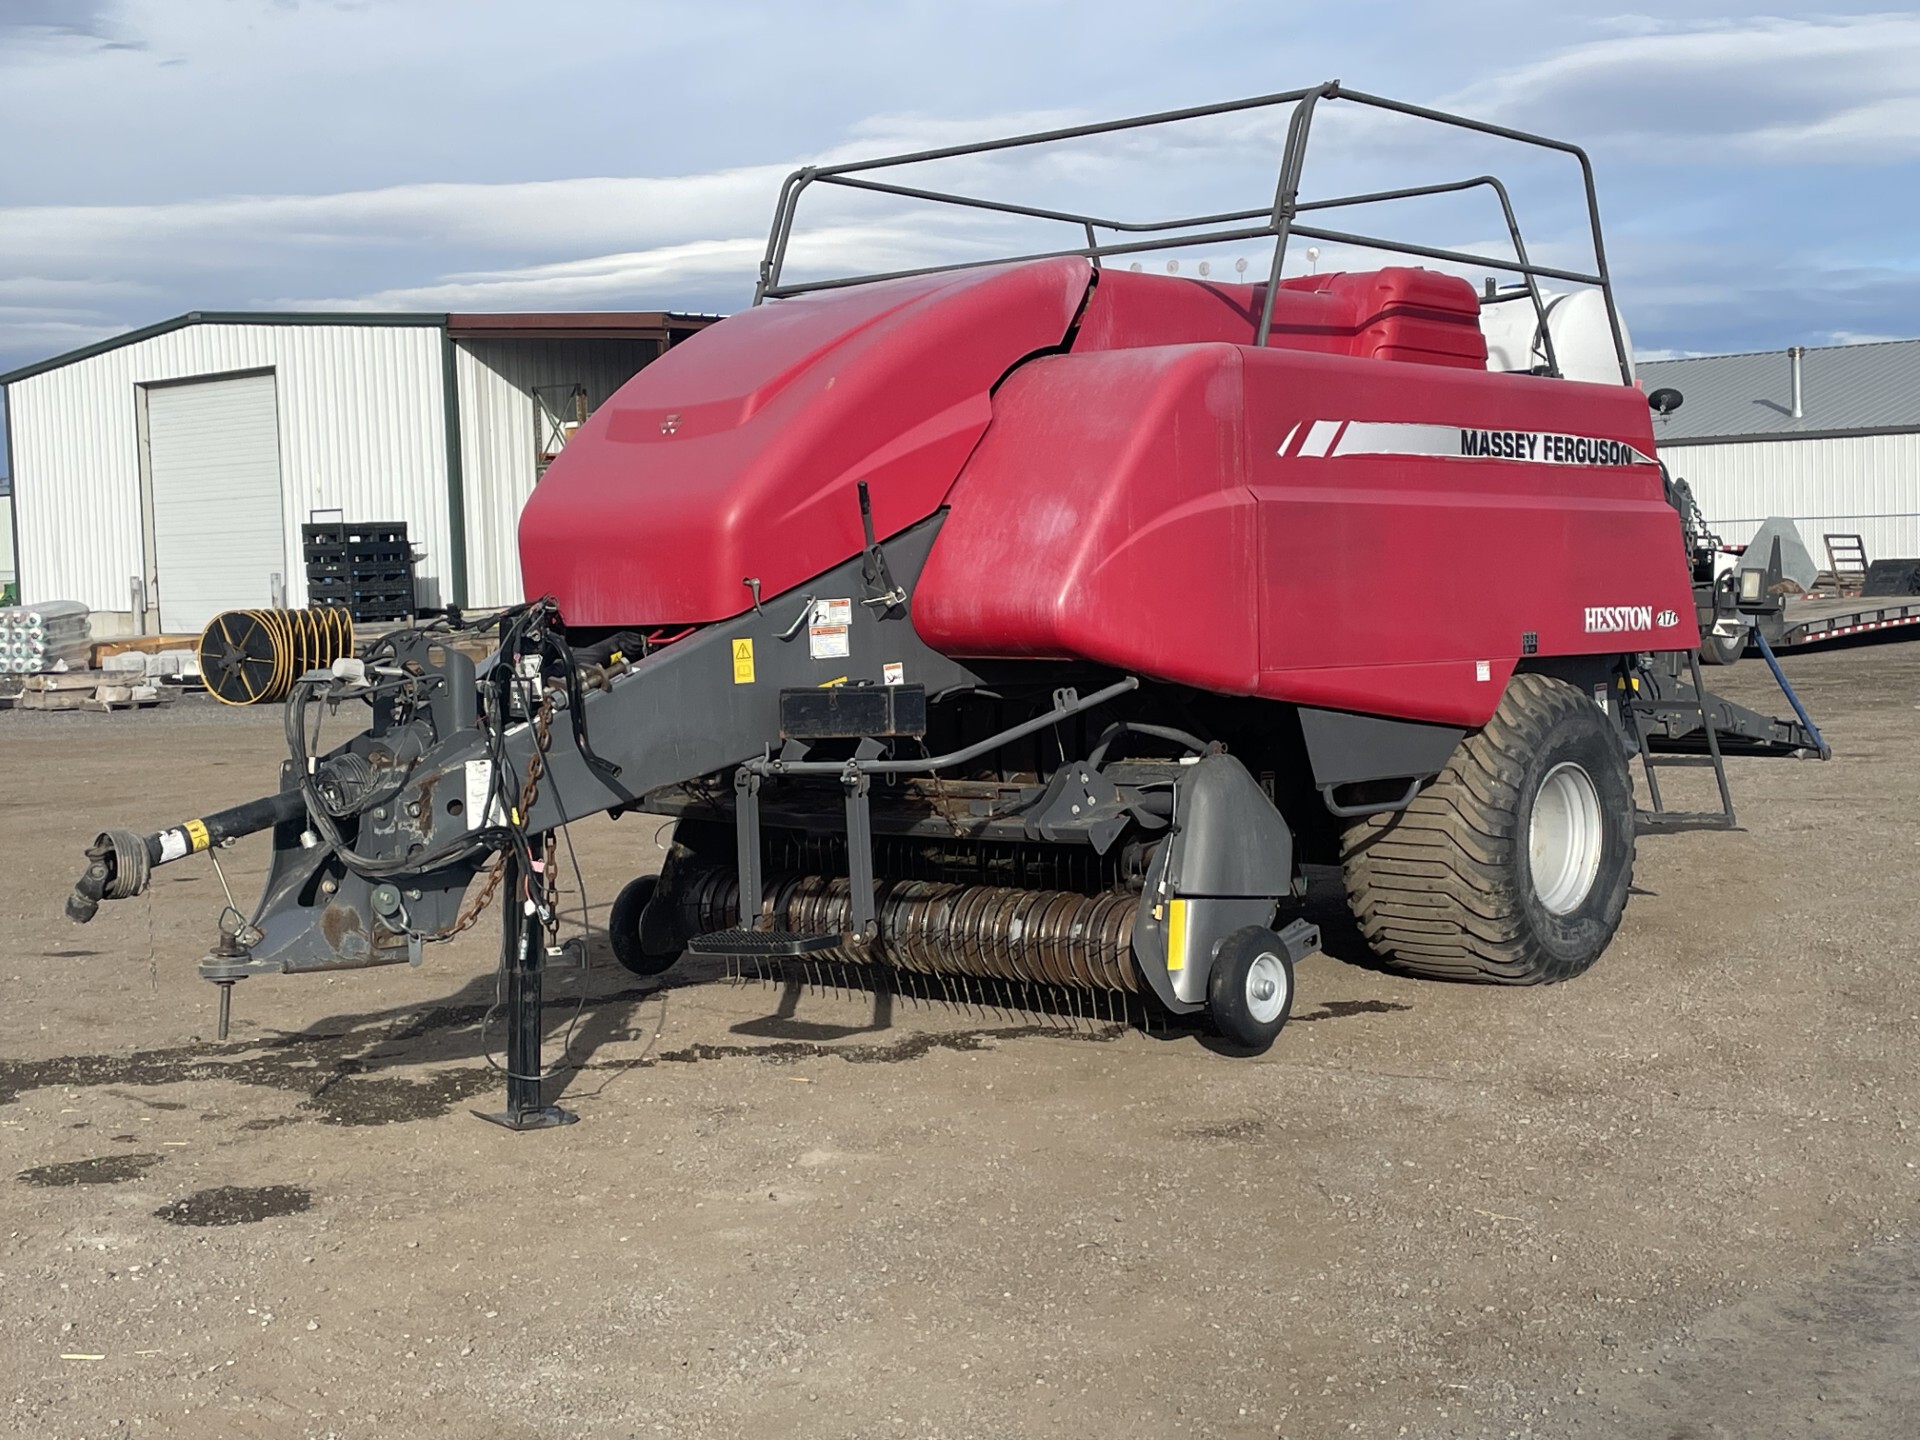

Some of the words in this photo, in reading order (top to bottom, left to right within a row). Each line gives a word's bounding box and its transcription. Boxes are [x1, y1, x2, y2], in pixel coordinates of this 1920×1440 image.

[1460, 429, 1538, 460] MASSEY
[1543, 435, 1633, 466] FERGUSON
[1584, 606, 1653, 633] HESSTON
